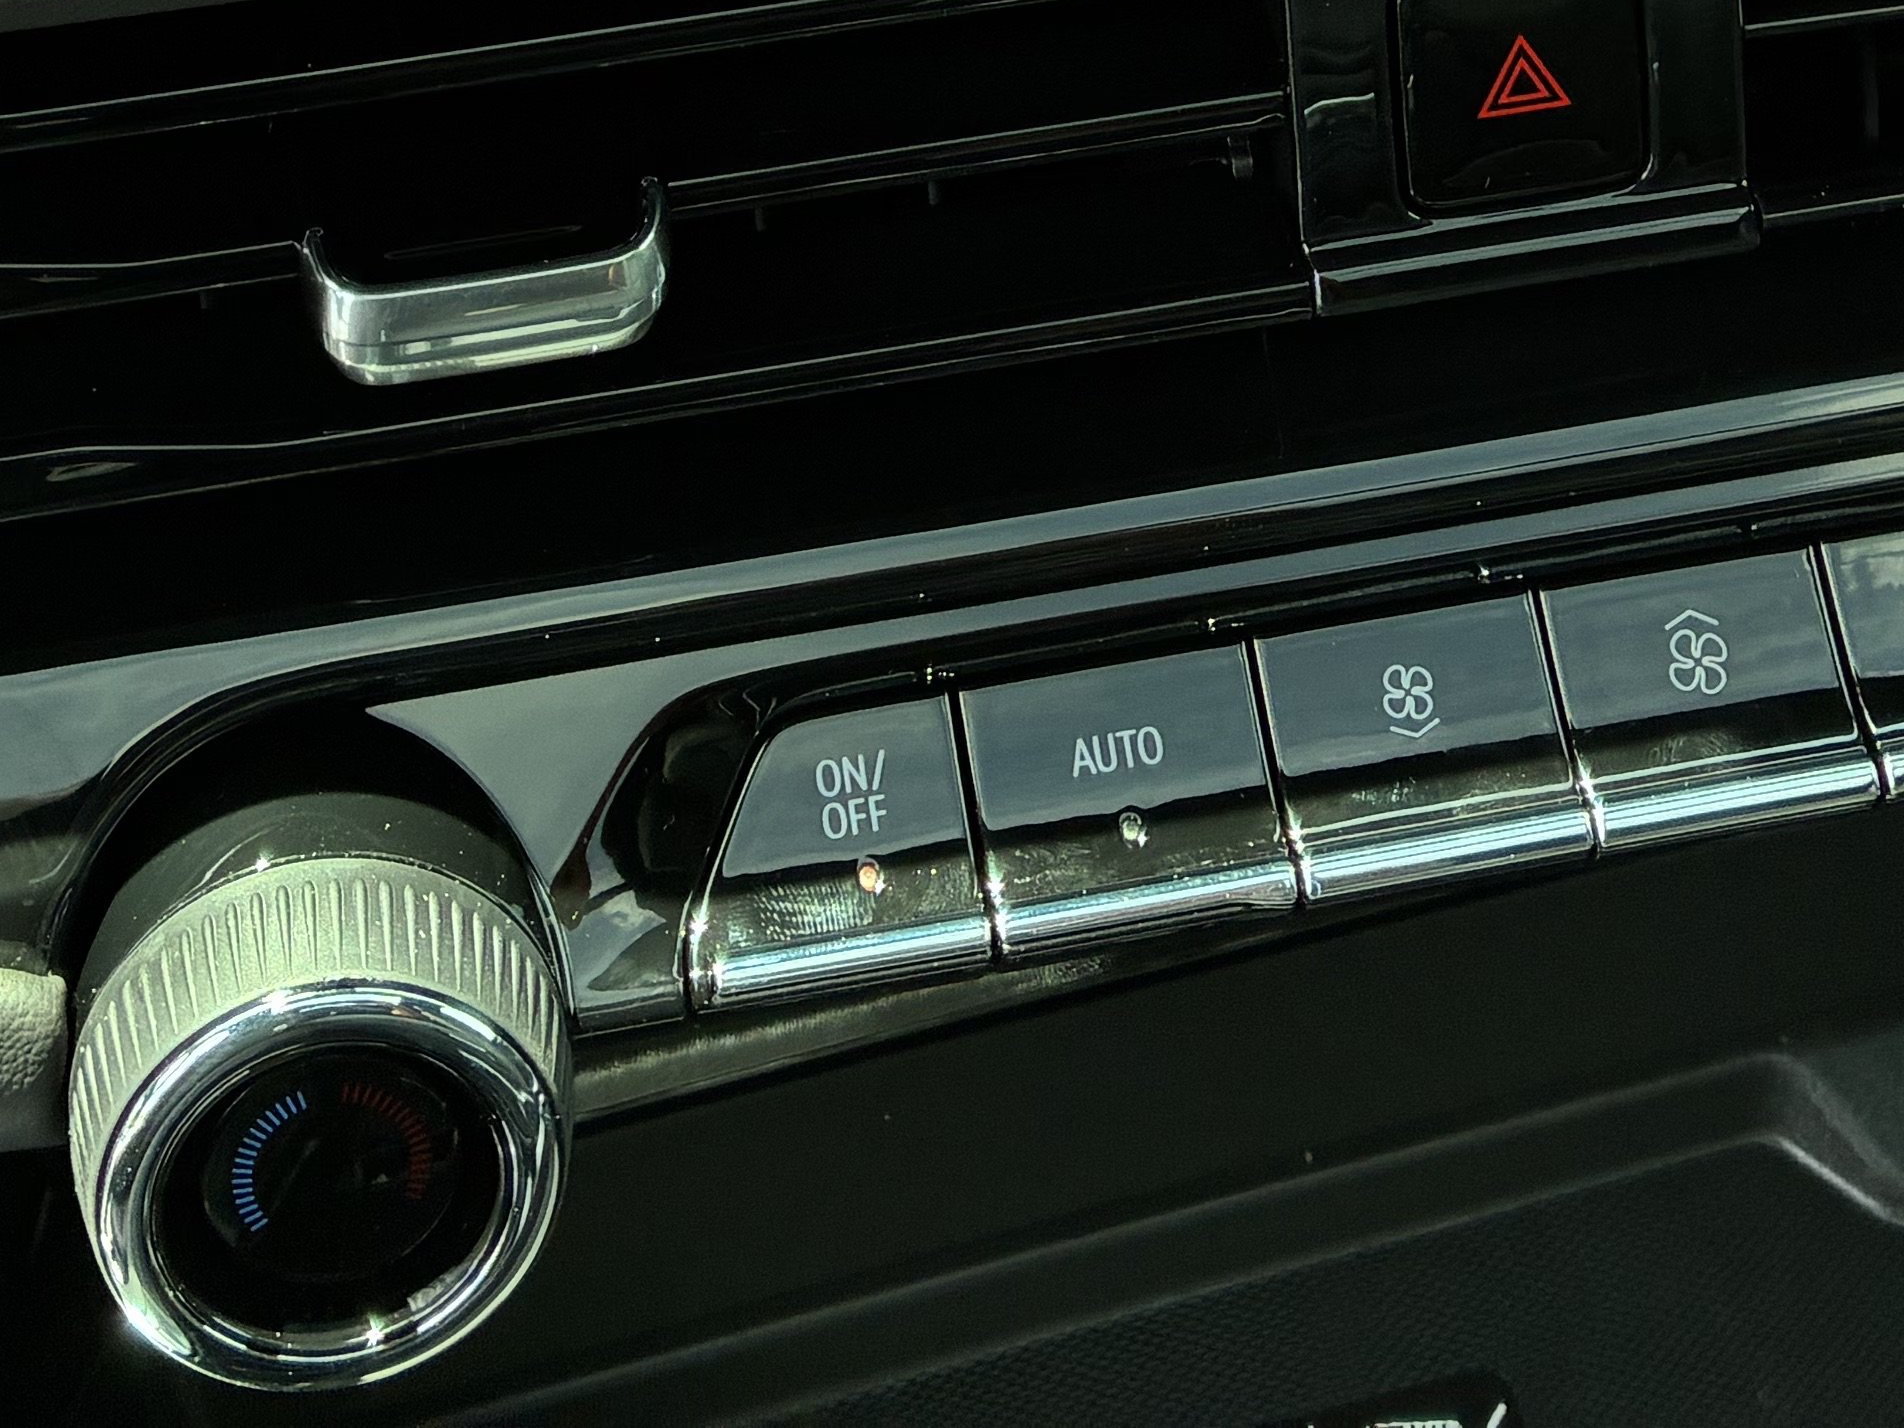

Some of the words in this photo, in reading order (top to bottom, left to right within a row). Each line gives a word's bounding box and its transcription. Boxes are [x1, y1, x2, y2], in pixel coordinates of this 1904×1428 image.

[816, 749, 885, 799] ON/
[1071, 725, 1165, 778] AUTO
[821, 794, 888, 841] OFF
